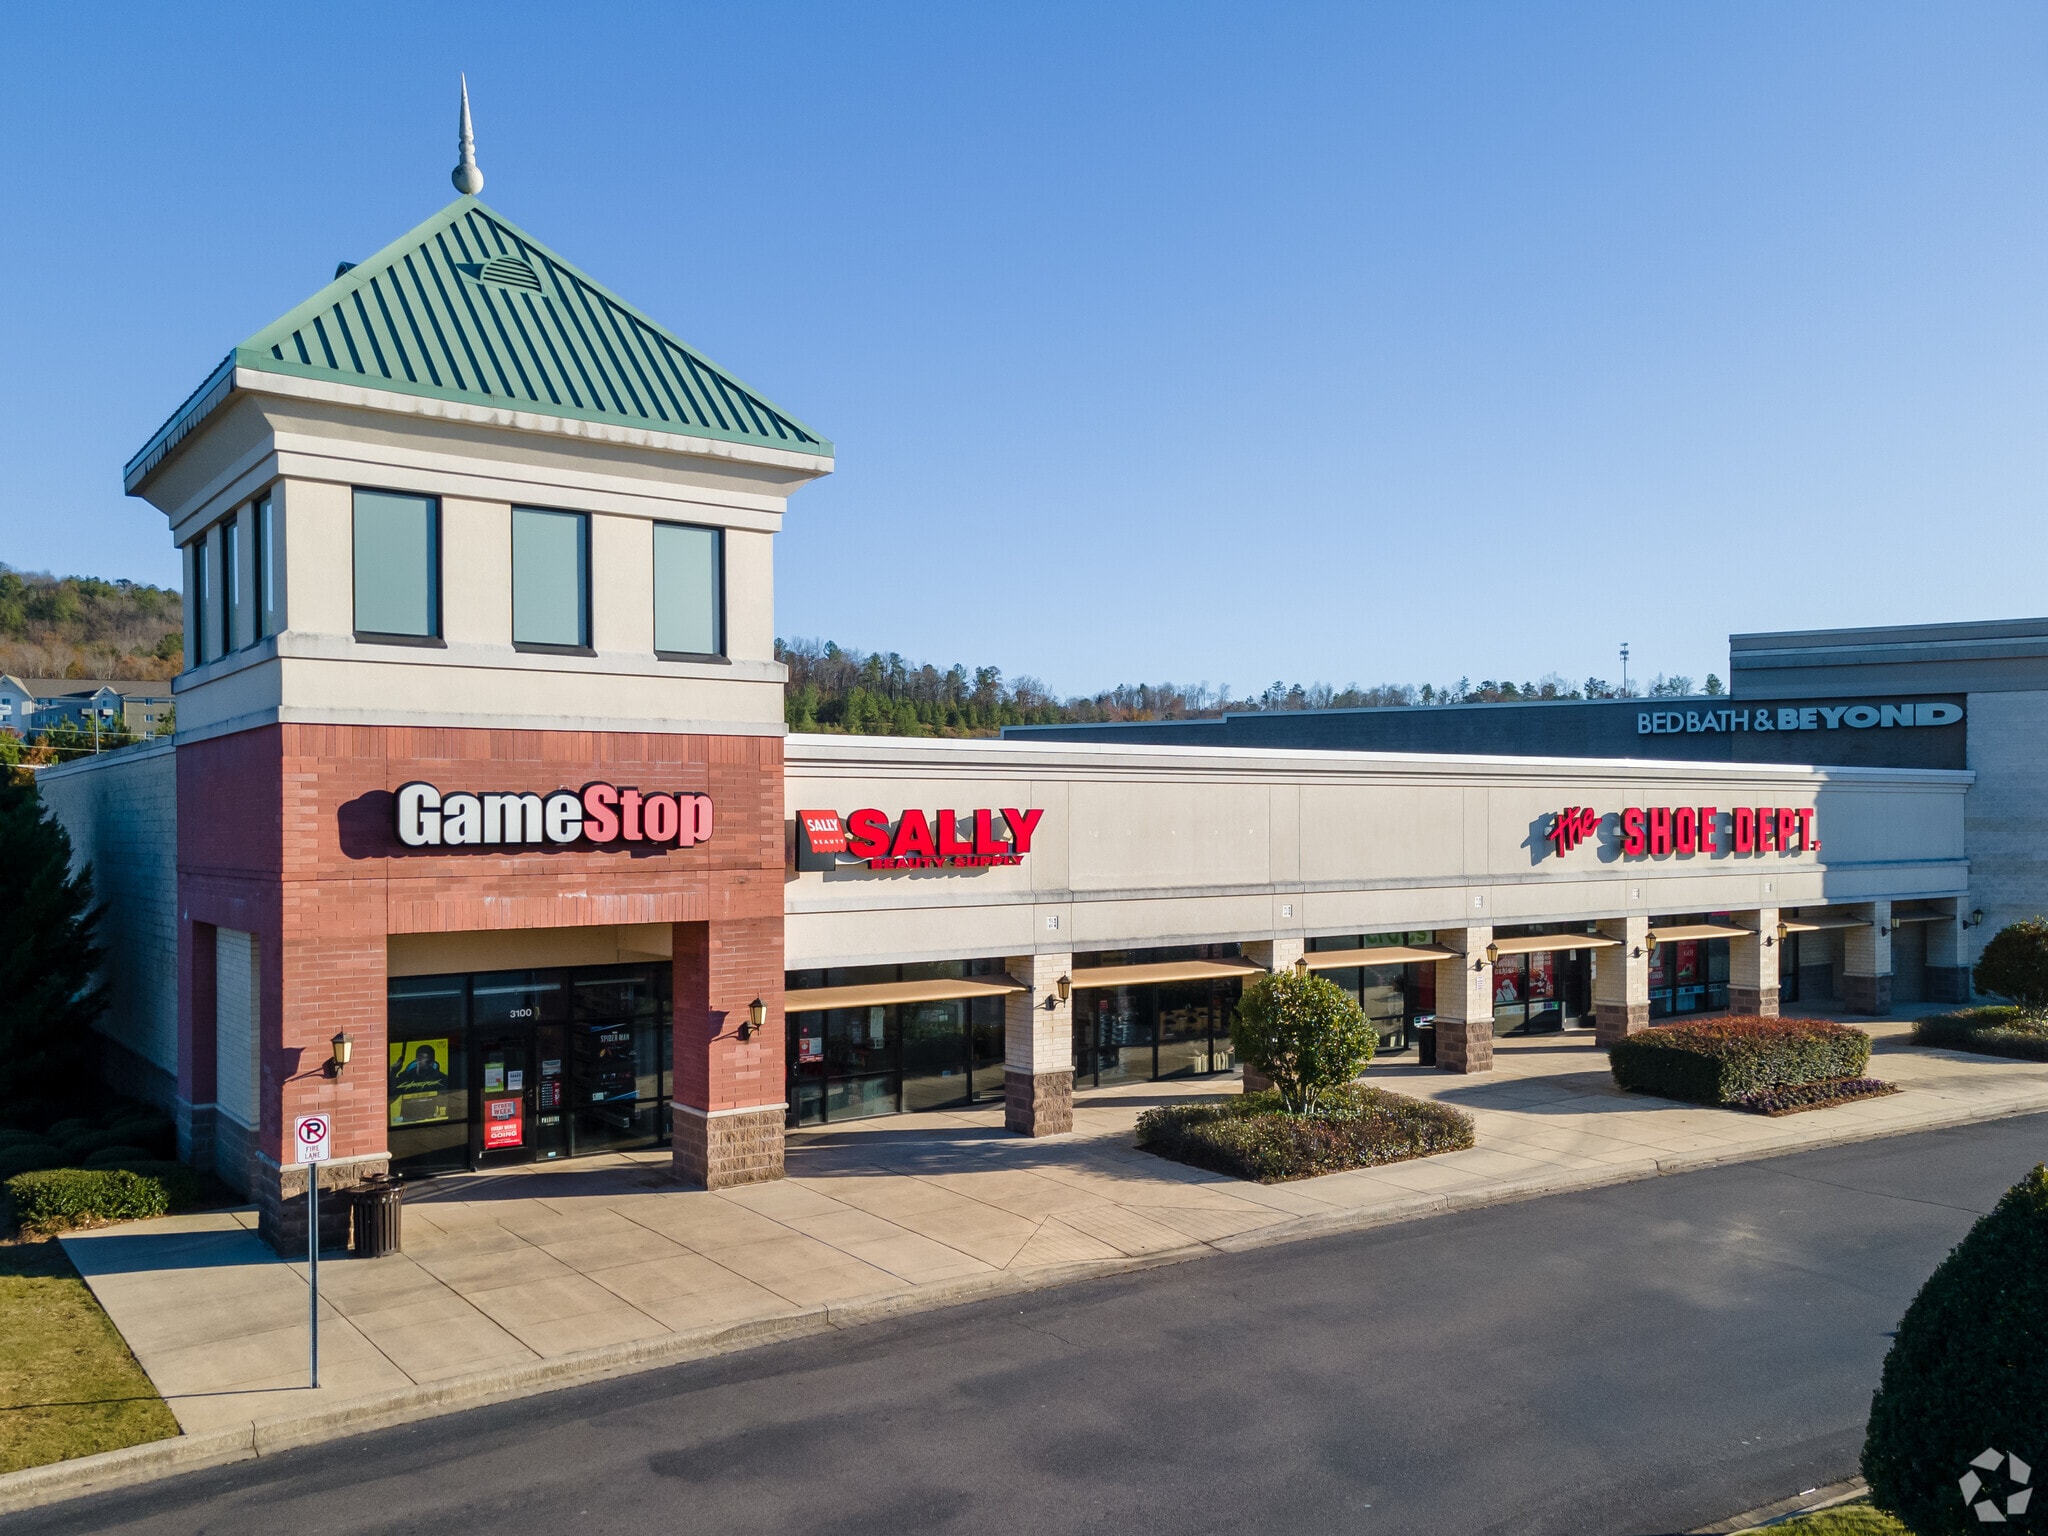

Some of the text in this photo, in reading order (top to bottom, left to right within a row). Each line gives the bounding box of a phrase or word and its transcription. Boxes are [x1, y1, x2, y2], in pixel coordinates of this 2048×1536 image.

[1753, 708, 1774, 731] &
[1777, 702, 1964, 730] BEYOND
[397, 782, 714, 848] GameStop
[807, 818, 839, 832] SALLY
[847, 808, 1044, 858] SALLY
[1621, 806, 1717, 856] SHOE
[1732, 807, 1822, 852] DEPT.
[868, 855, 1024, 870] BEAUTY SUPPLY
[510, 1008, 532, 1018] 3100
[305, 1152, 321, 1160] LANE
